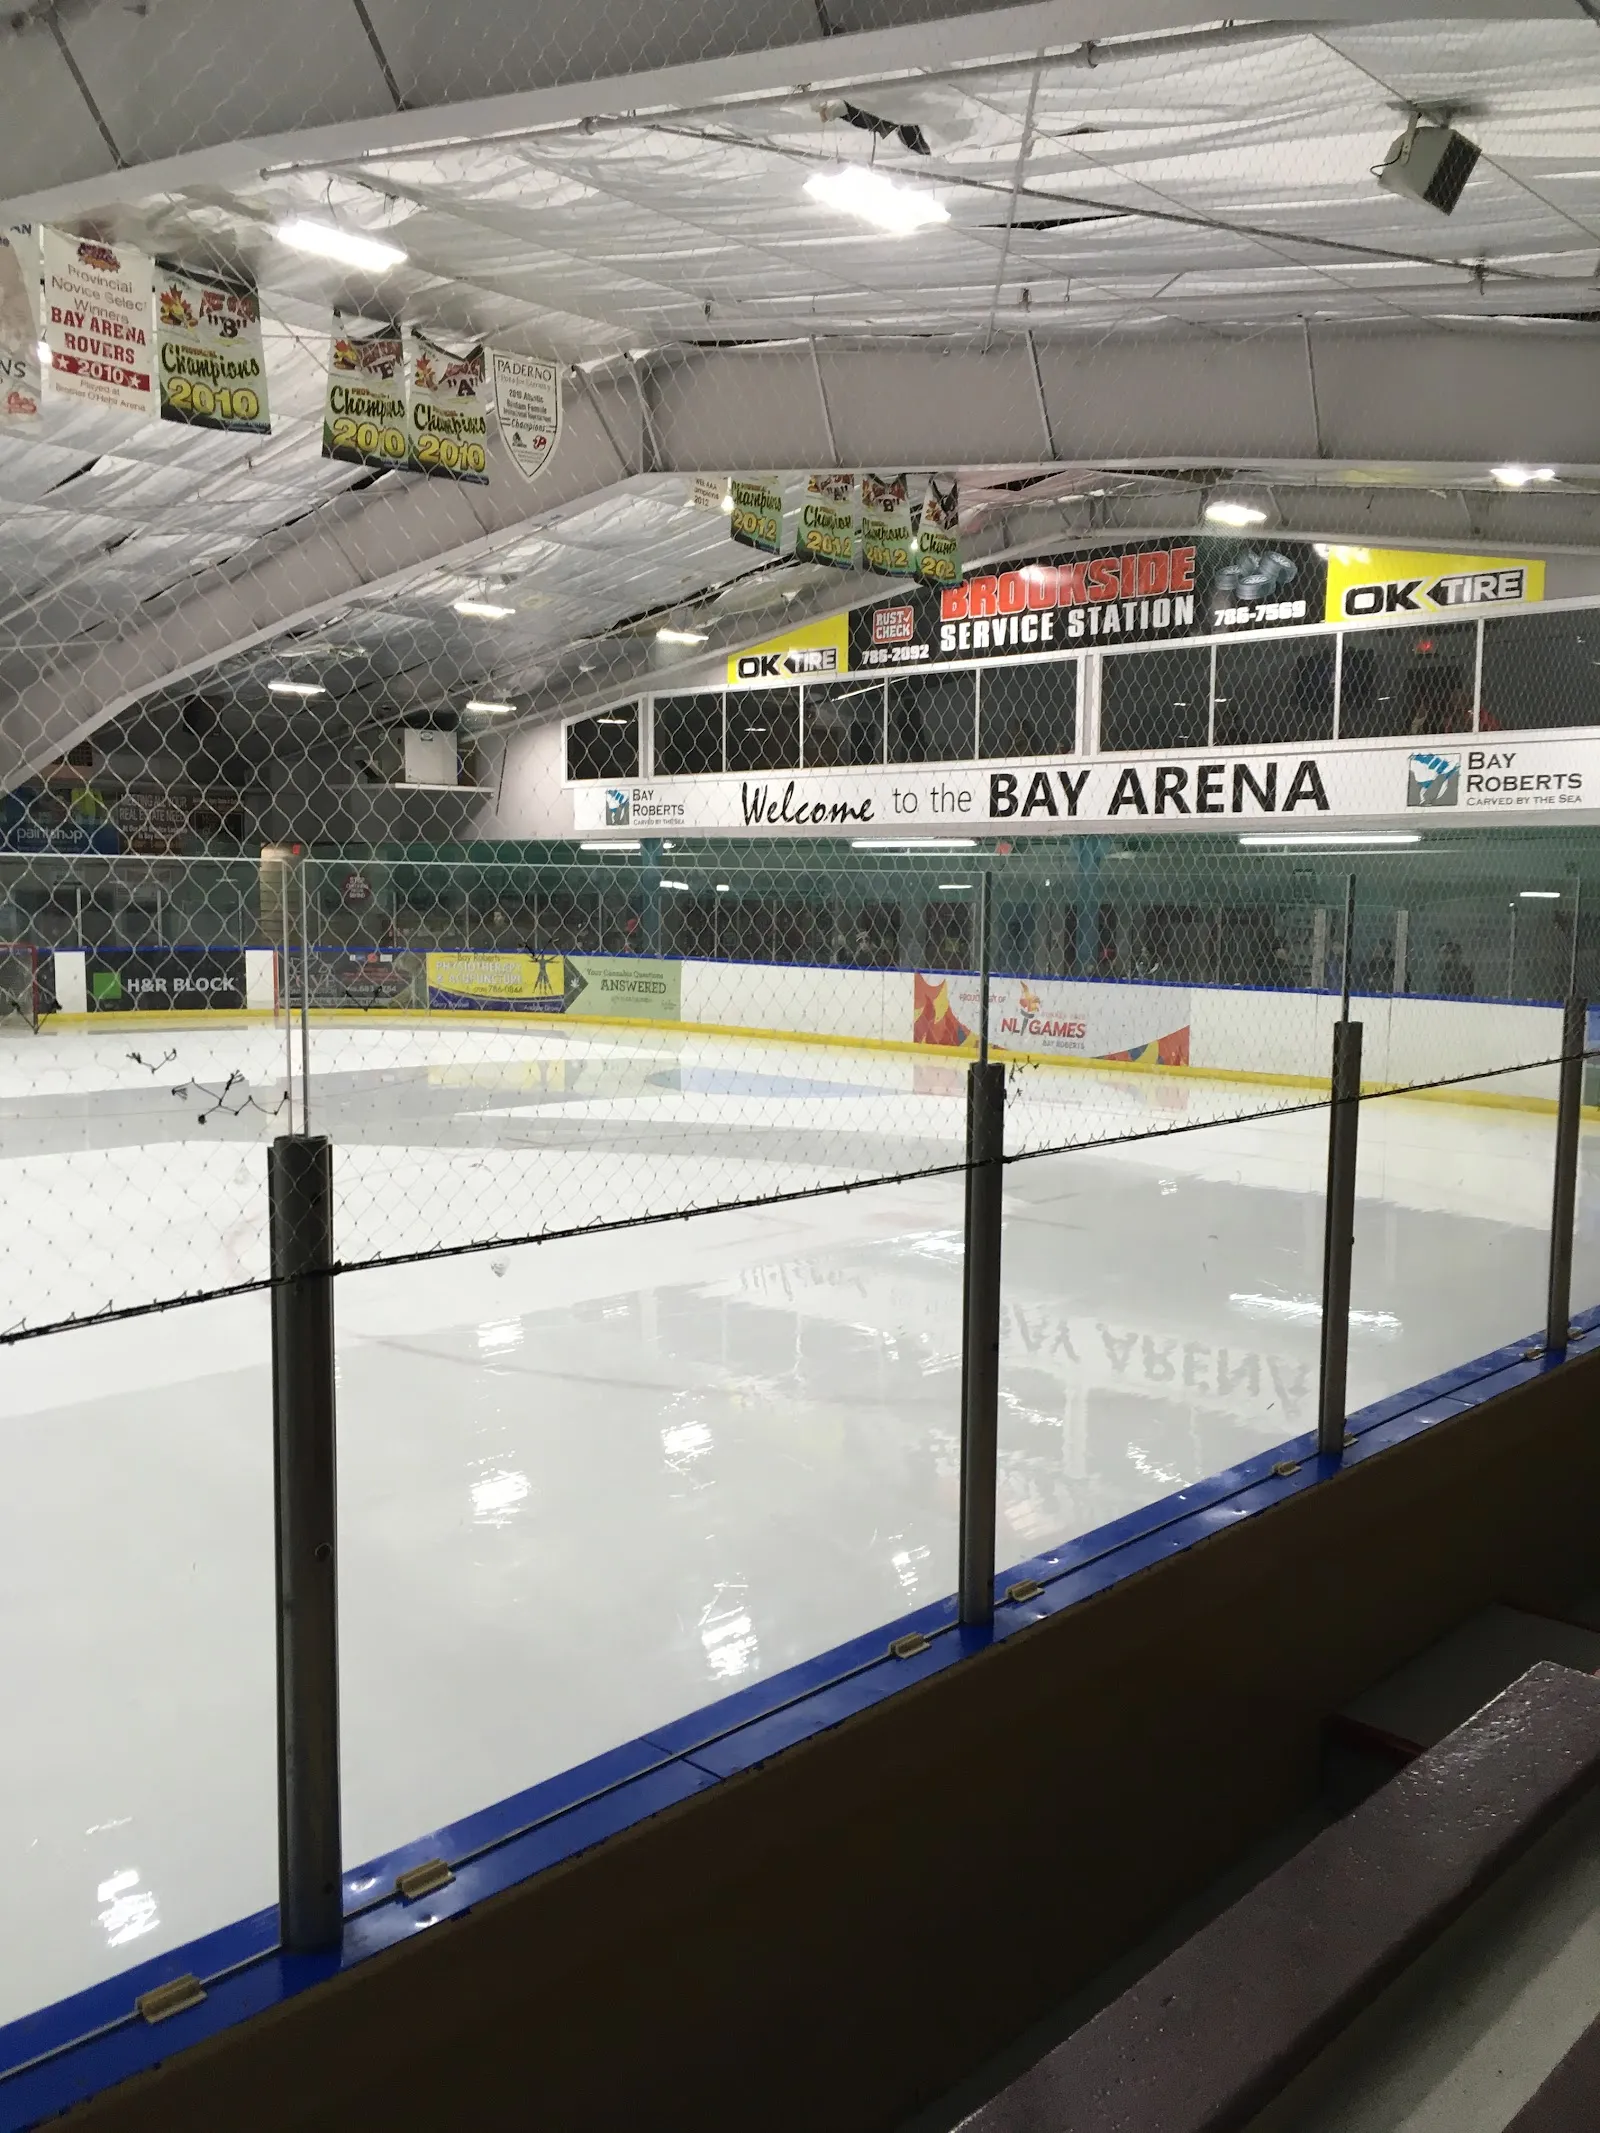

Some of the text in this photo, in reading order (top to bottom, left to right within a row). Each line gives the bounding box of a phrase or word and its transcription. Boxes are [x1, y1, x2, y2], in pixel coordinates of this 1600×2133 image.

[52, 275, 100, 300] Novice
[68, 264, 132, 293] Provincial
[74, 297, 129, 324] Winners
[51, 306, 146, 346] BAY ARENA
[64, 332, 135, 365] ROVERS
[77, 359, 124, 384] 2010
[161, 342, 260, 387] Champions
[498, 359, 552, 382] PADERNO
[167, 376, 259, 420] 2010
[418, 433, 486, 473] 2010
[694, 495, 709, 507] 2012
[731, 508, 777, 543] 2012
[806, 530, 852, 559] 2012
[866, 542, 909, 568] 2012
[940, 546, 1196, 622] BROOKSIDE
[1345, 571, 1521, 616] OK TIRE
[876, 611, 904, 626] RUST
[940, 595, 1194, 652] SERVICE STATION
[1214, 601, 1307, 627] 786-7569
[876, 624, 910, 639] CHECK
[738, 649, 836, 679] OK TIRE
[862, 644, 929, 665] 786-2092
[1468, 751, 1517, 770] BAY
[633, 788, 654, 801] BAY
[741, 759, 1331, 826] Welcome to the BAY ARENA
[1466, 773, 1583, 793] ROBERTS
[633, 804, 685, 817] ROBERTS
[1466, 794, 1582, 806] CARVED BY THE SEA
[119, 808, 138, 821] REAL
[139, 808, 165, 821] EATE
[436, 961, 522, 972] PHYSIOTHERAPY
[457, 952, 501, 964] Bay Roberts
[127, 977, 237, 993] H&R BLOCK
[448, 973, 522, 985] ACUPUNCTURE
[586, 968, 664, 979] Your Cannabis Questions
[600, 979, 667, 994] ANSWERED
[1001, 1018, 1086, 1039] NL GAMES
[1056, 1041, 1085, 1050] ROBERTS
